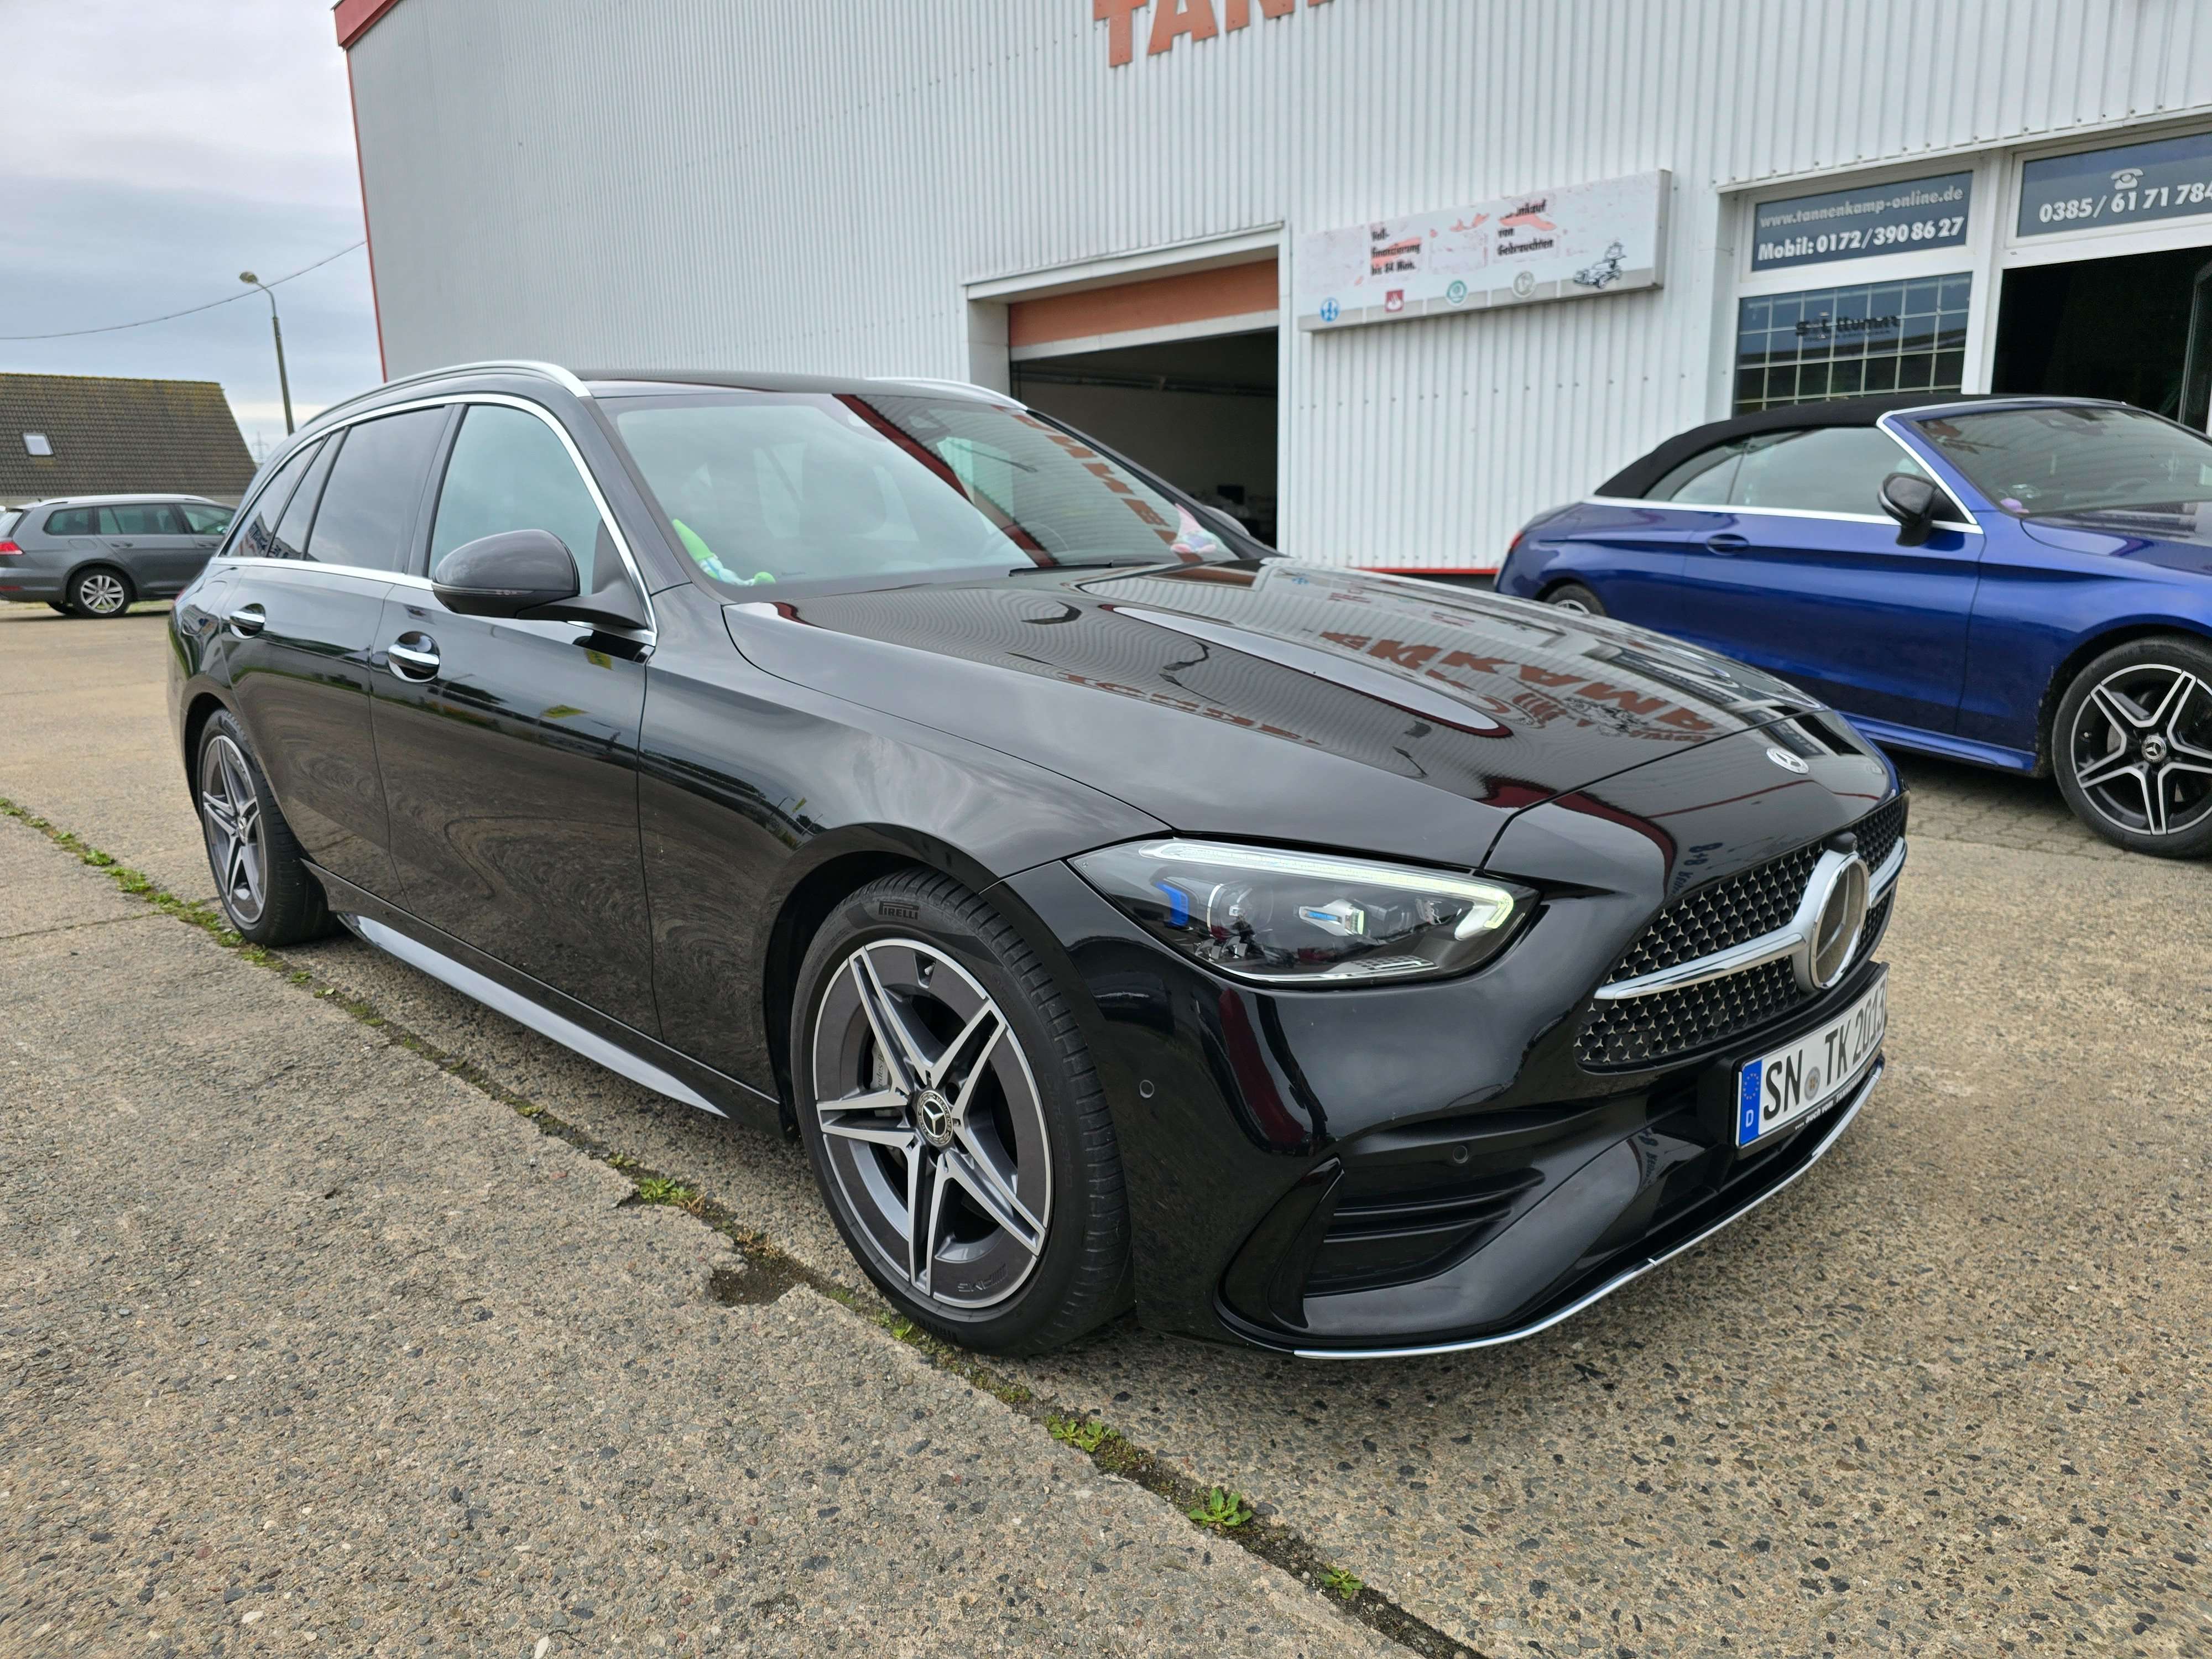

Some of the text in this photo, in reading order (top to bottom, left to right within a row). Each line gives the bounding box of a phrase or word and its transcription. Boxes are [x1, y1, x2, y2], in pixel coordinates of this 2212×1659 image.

[1093, 0, 1328, 67] TA
[1760, 185, 1963, 228] www.tannenkamp-online.de
[878, 900, 920, 920] PIRELLI
[1763, 1049, 1803, 1121] SN
[1824, 1019, 1851, 1086] TK
[1745, 1109, 1754, 1128] D
